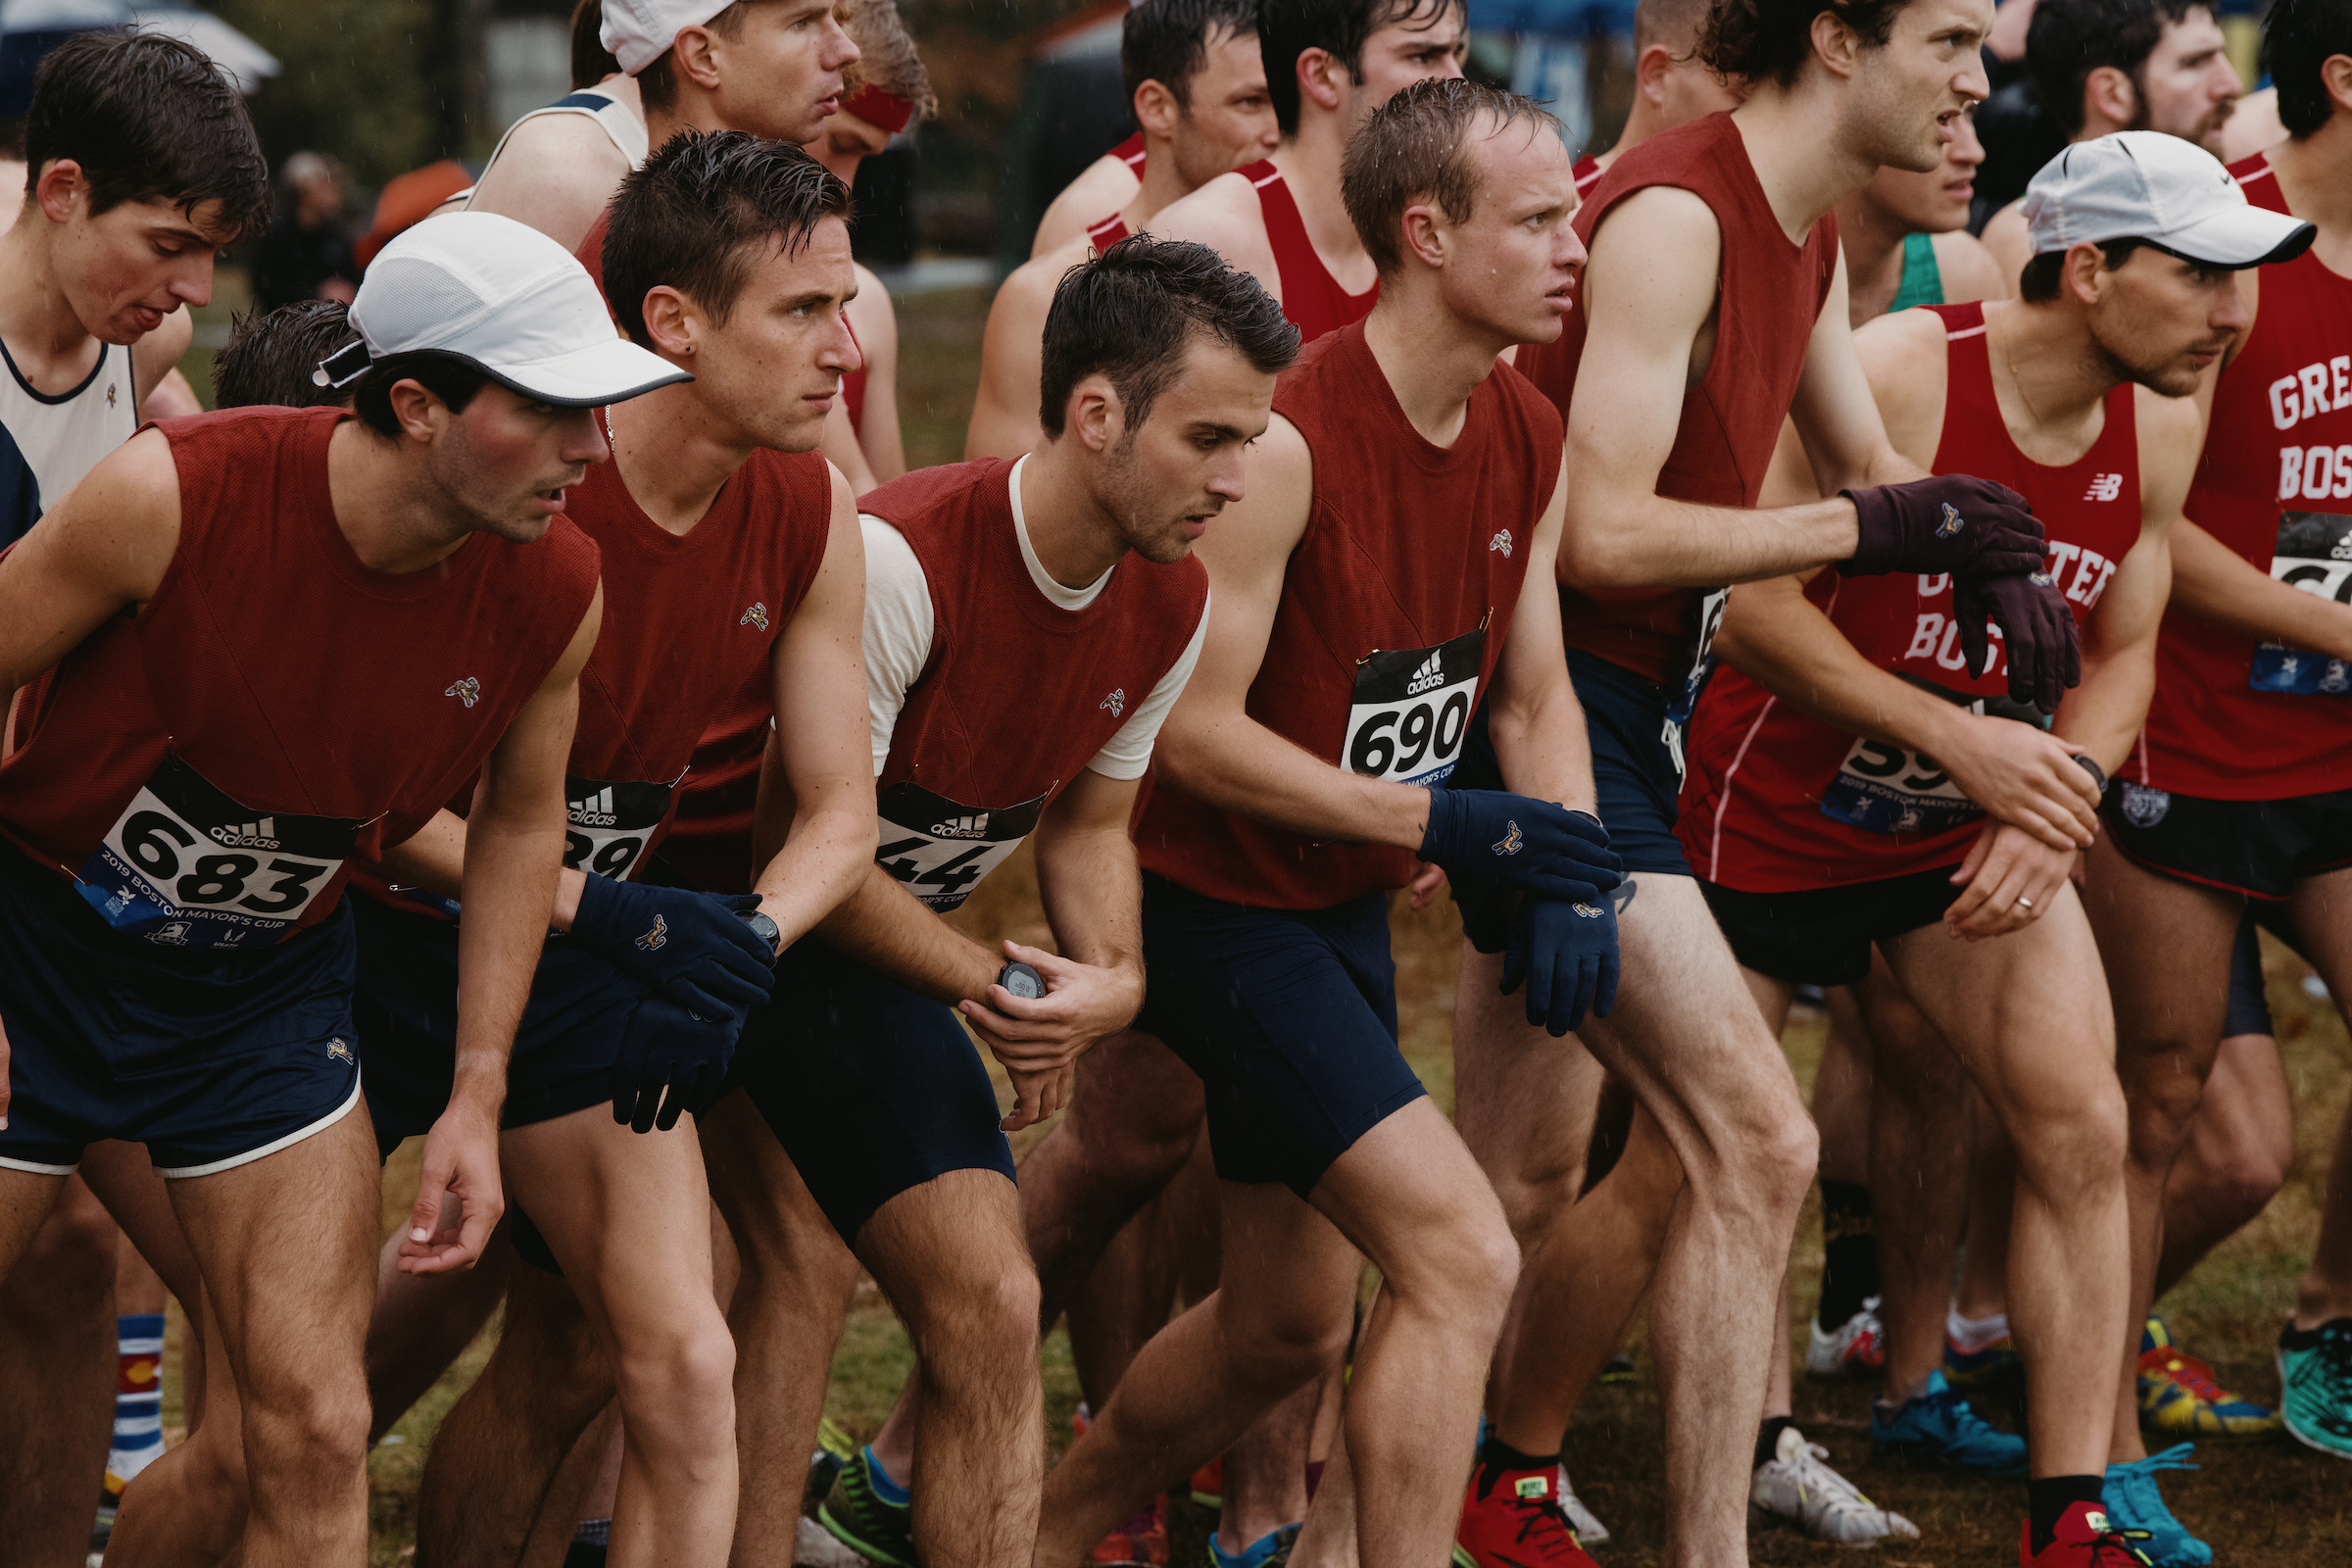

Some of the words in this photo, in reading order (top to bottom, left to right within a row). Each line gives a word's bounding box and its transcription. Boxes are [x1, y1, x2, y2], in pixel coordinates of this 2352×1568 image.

[1407, 672, 1445, 695] adidas
[1349, 691, 1468, 778] 690
[1440, 764, 1455, 779] CUP
[1867, 784, 1918, 806] BOSTON
[567, 809, 617, 825] didas
[210, 825, 280, 850] adidas
[930, 822, 988, 839] adidas
[122, 810, 328, 912] 683
[101, 850, 130, 877] 2019
[130, 876, 184, 918] BOSTON
[185, 908, 253, 927] MAYOR'S
[254, 919, 286, 931] CUP
